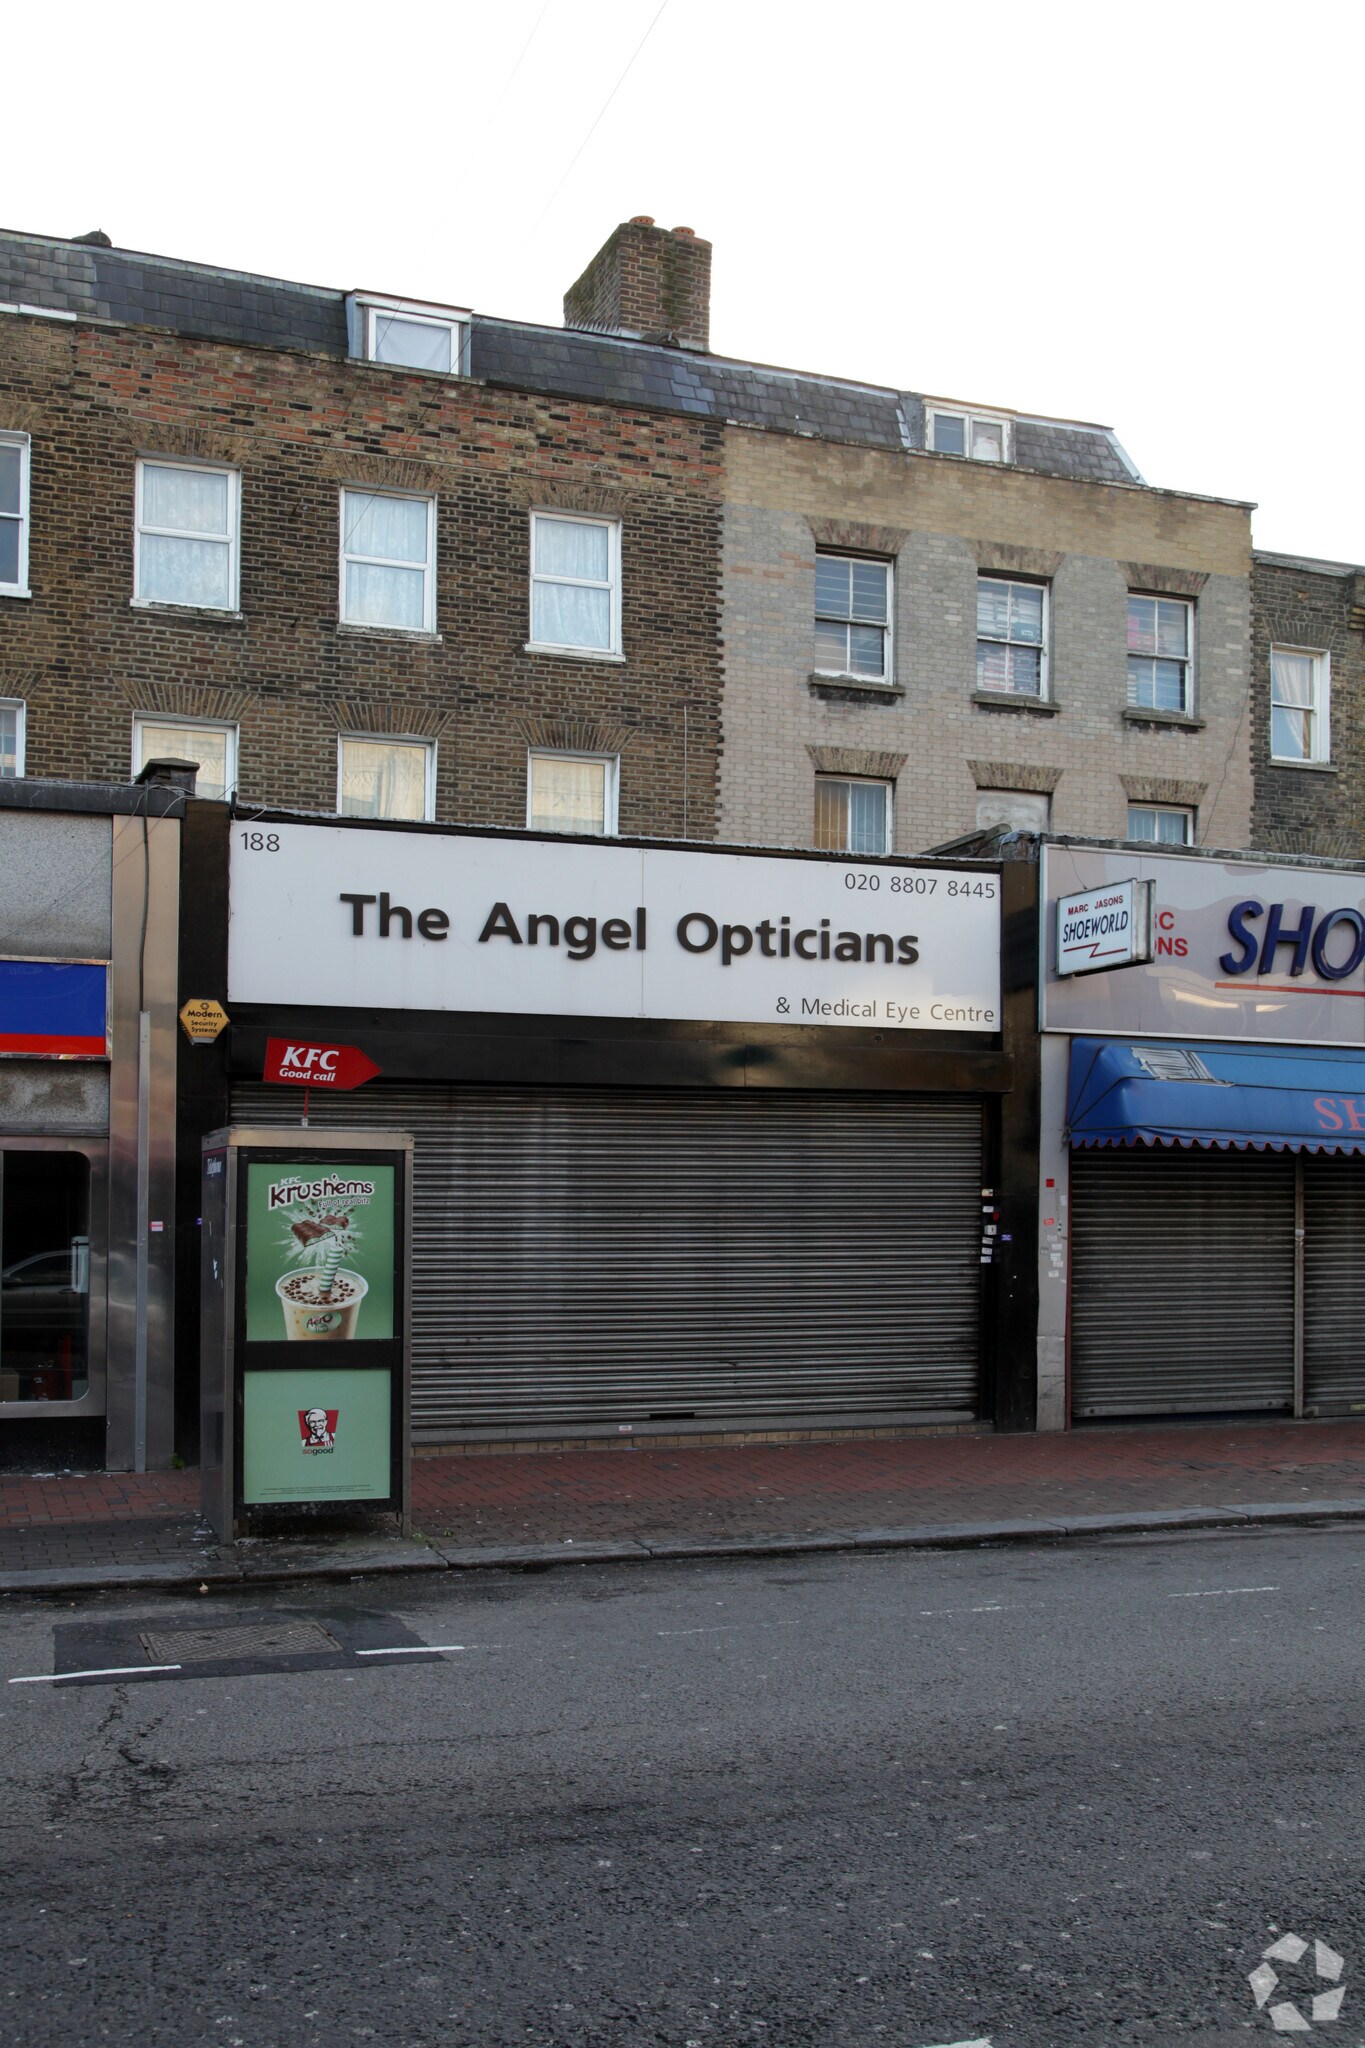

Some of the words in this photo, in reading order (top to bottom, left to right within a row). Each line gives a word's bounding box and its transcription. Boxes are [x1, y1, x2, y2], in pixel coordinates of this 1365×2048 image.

[240, 832, 281, 853] 188
[844, 873, 881, 892] 020
[890, 876, 938, 895] 8807
[947, 880, 996, 899] 8445
[1067, 903, 1089, 916] MARC
[1094, 895, 1124, 910] JASONS
[340, 892, 450, 942] The
[478, 902, 647, 961] Angel
[676, 912, 920, 966] Opticians
[1063, 910, 1129, 943] SHOEWORLD
[187, 1010, 222, 1019] Modern
[775, 996, 791, 1015] &
[801, 998, 877, 1018] Medical
[886, 1001, 921, 1024] Eye
[930, 1004, 995, 1023] Centre
[281, 1046, 340, 1071] KFC
[279, 1067, 312, 1080] Good
[313, 1072, 336, 1082] call
[280, 1176, 302, 1186] KFC
